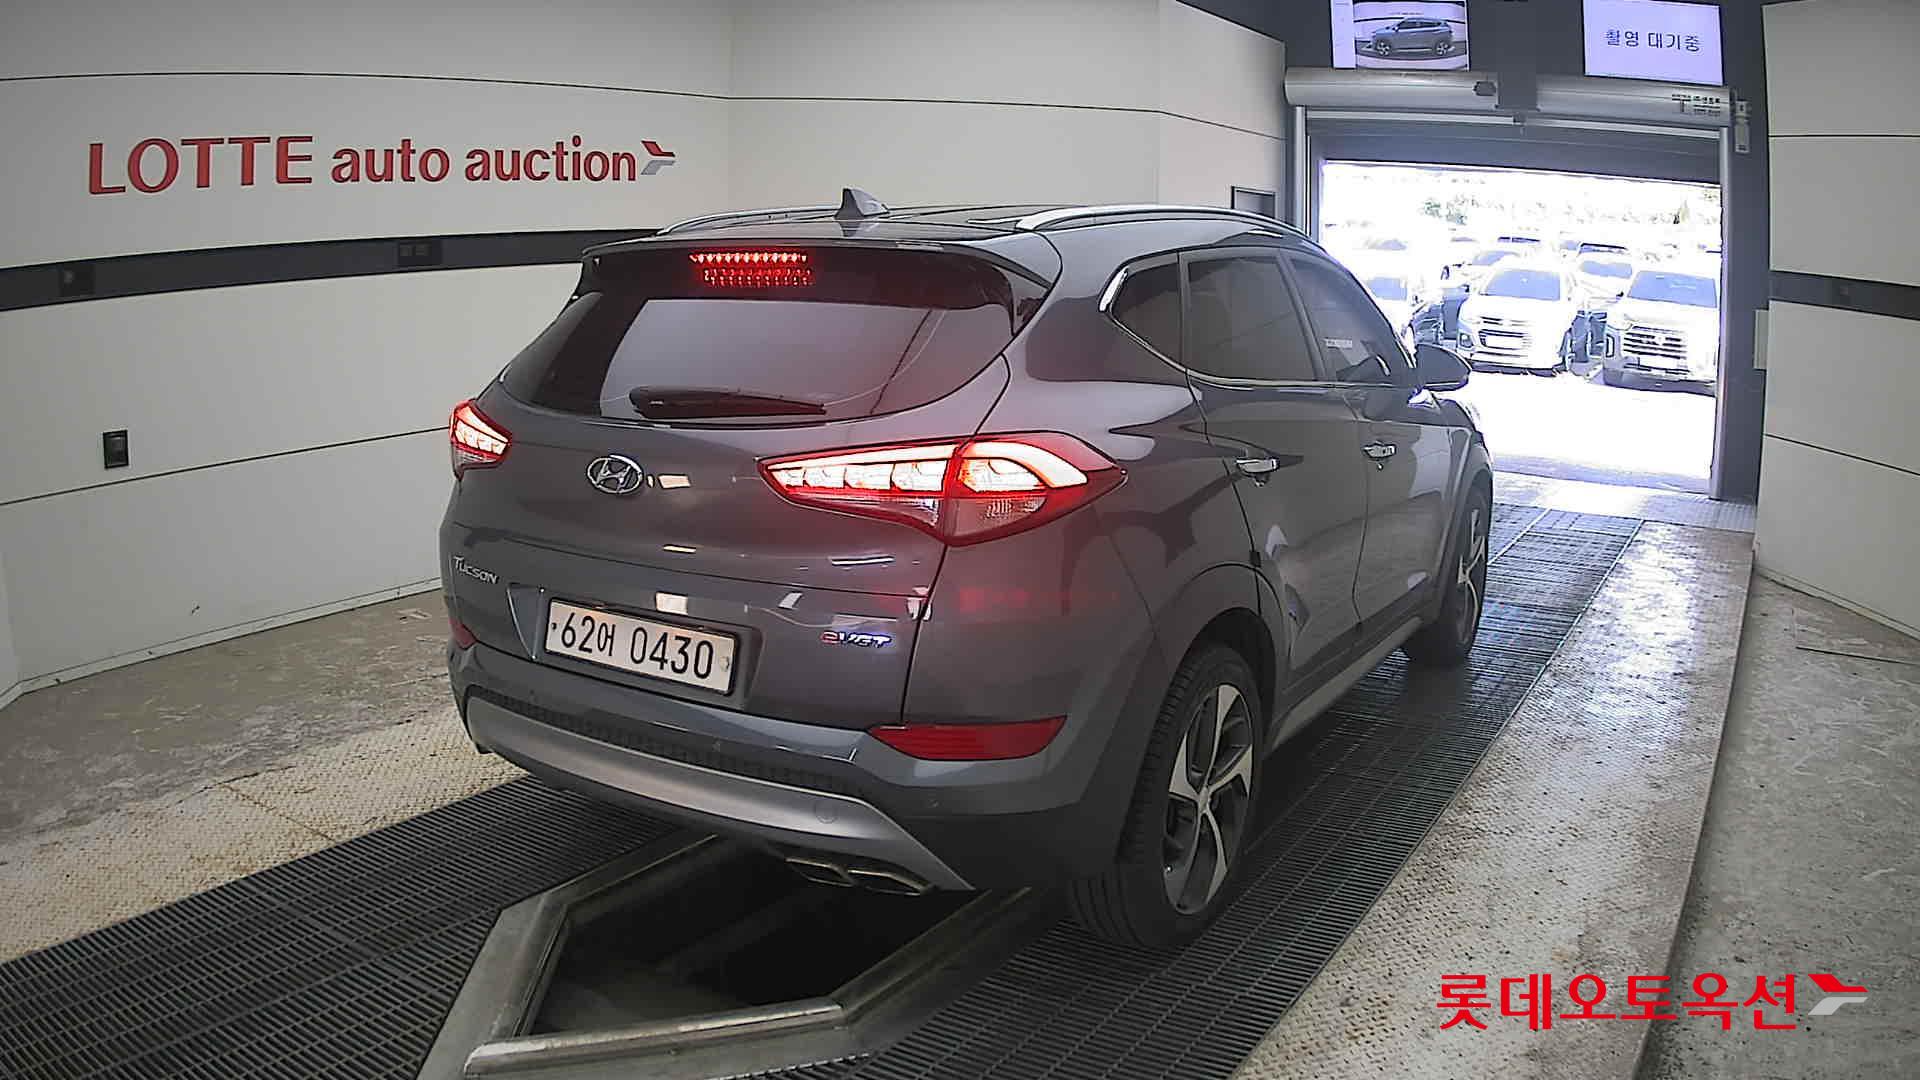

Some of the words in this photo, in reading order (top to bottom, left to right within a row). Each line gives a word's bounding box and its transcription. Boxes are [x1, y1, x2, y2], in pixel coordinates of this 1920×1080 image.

[1647, 32, 1700, 52] 대기중
[89, 136, 313, 195] LOTTE
[330, 138, 450, 183] auto
[464, 135, 637, 182] auction
[561, 612, 616, 657] 62어
[630, 626, 714, 679] 0430
